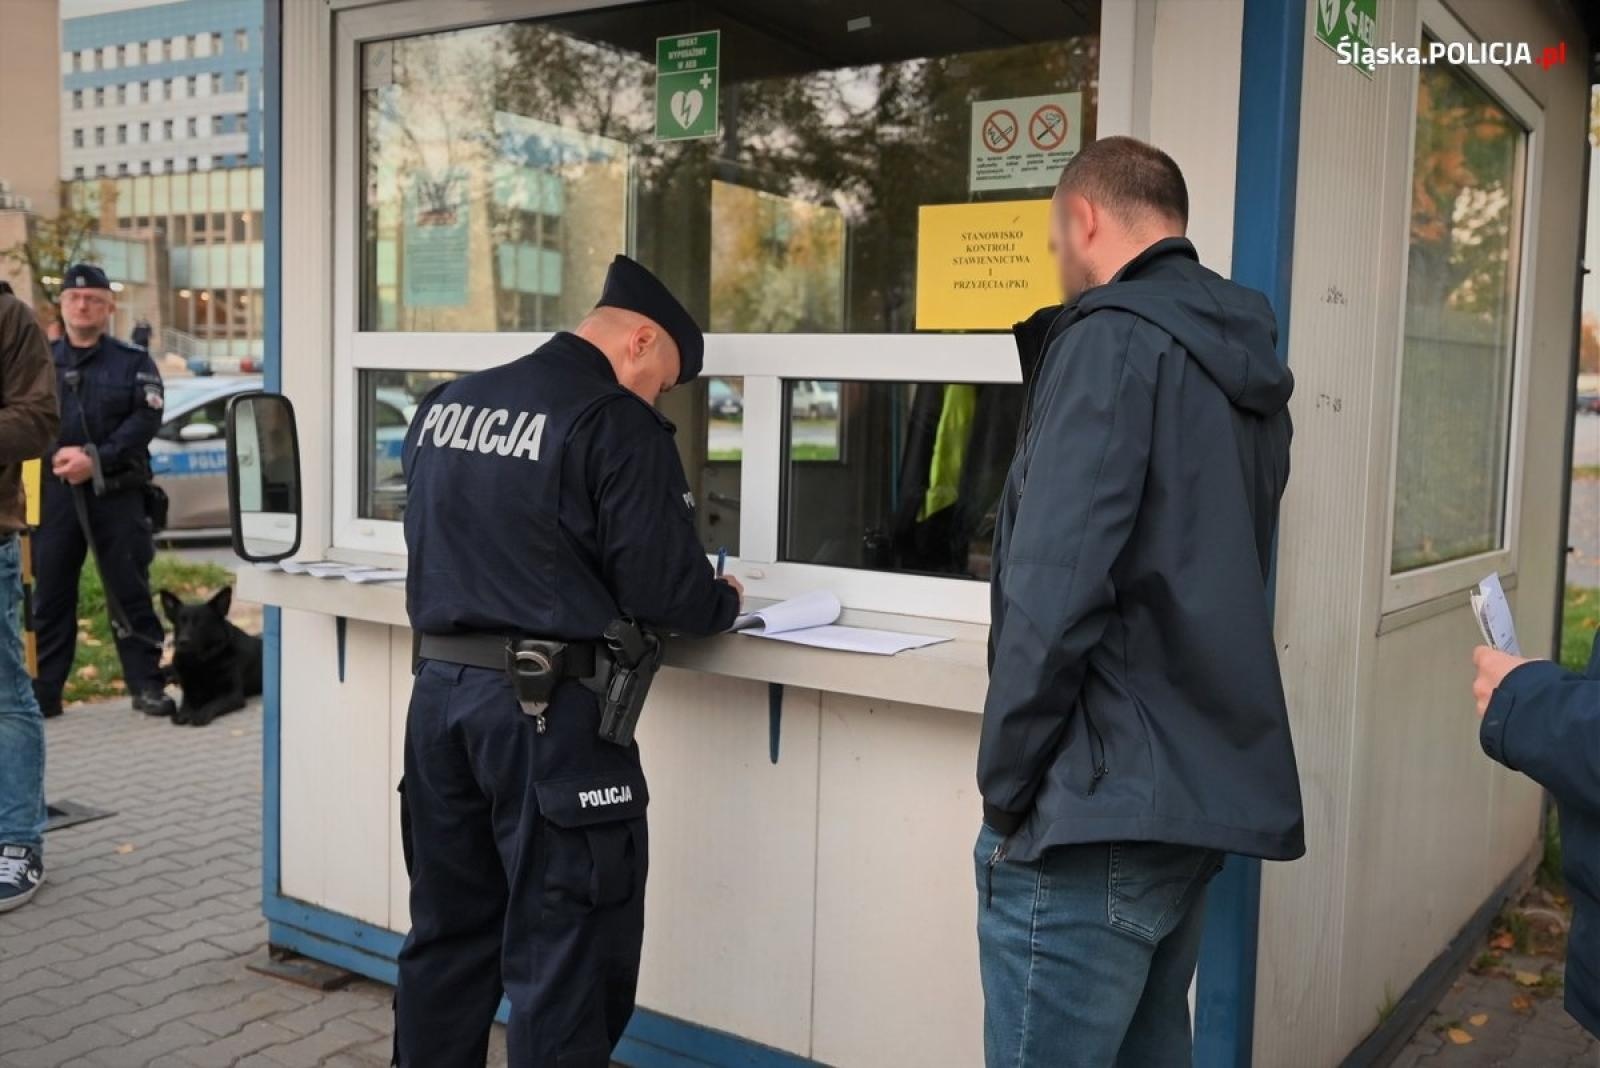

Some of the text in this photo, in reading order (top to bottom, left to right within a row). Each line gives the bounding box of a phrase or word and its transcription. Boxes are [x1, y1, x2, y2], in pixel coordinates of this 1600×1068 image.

[960, 231, 1024, 241] STANOWISKO
[966, 243, 1016, 253] KONTROLI
[952, 255, 1030, 265] STAWIENNICTWA
[953, 279, 1029, 290] PRZYJĘCIA (PKI)
[416, 403, 547, 461] POLICJA
[578, 785, 633, 808] POLICJA
